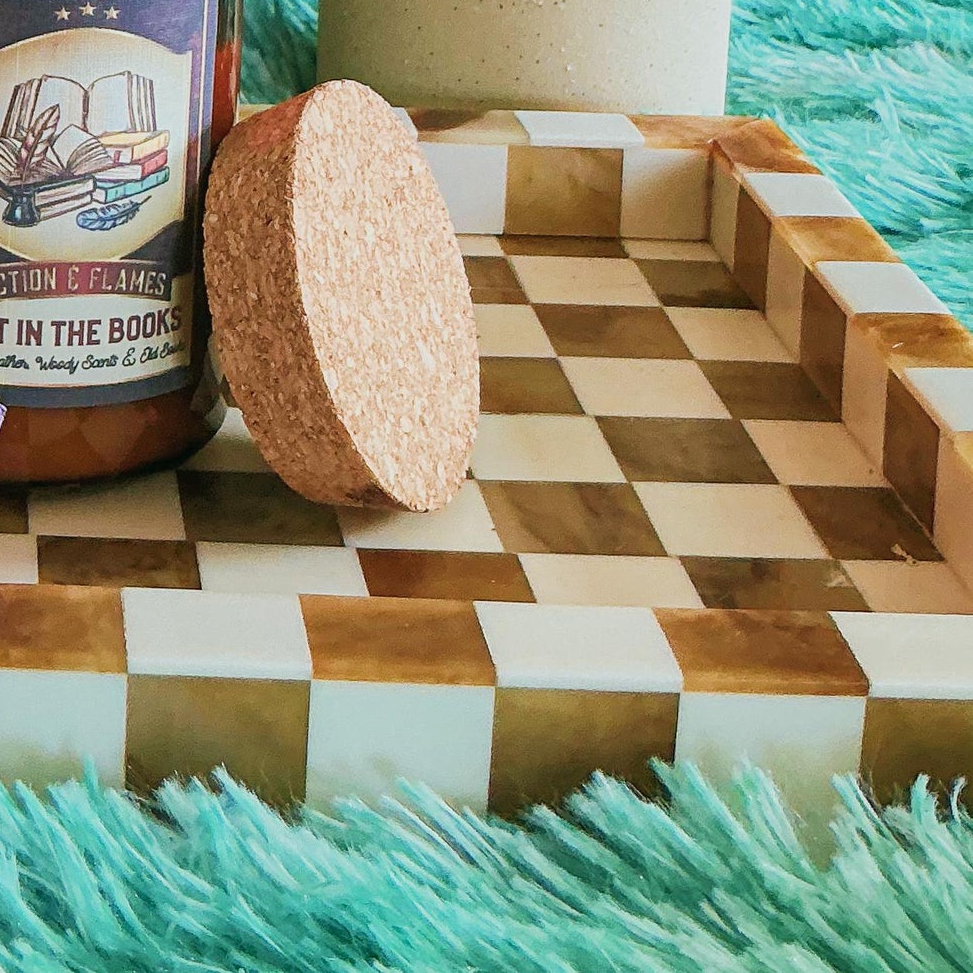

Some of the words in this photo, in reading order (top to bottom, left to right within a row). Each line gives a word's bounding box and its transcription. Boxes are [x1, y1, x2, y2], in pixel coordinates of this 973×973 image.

[89, 267, 166, 296] FLAMES
[16, 318, 44, 346] IN
[50, 318, 102, 346] THE
[108, 306, 181, 344] BOOKS
[35, 355, 80, 375] Woody
[81, 354, 119, 370] Scents
[122, 347, 137, 367] &
